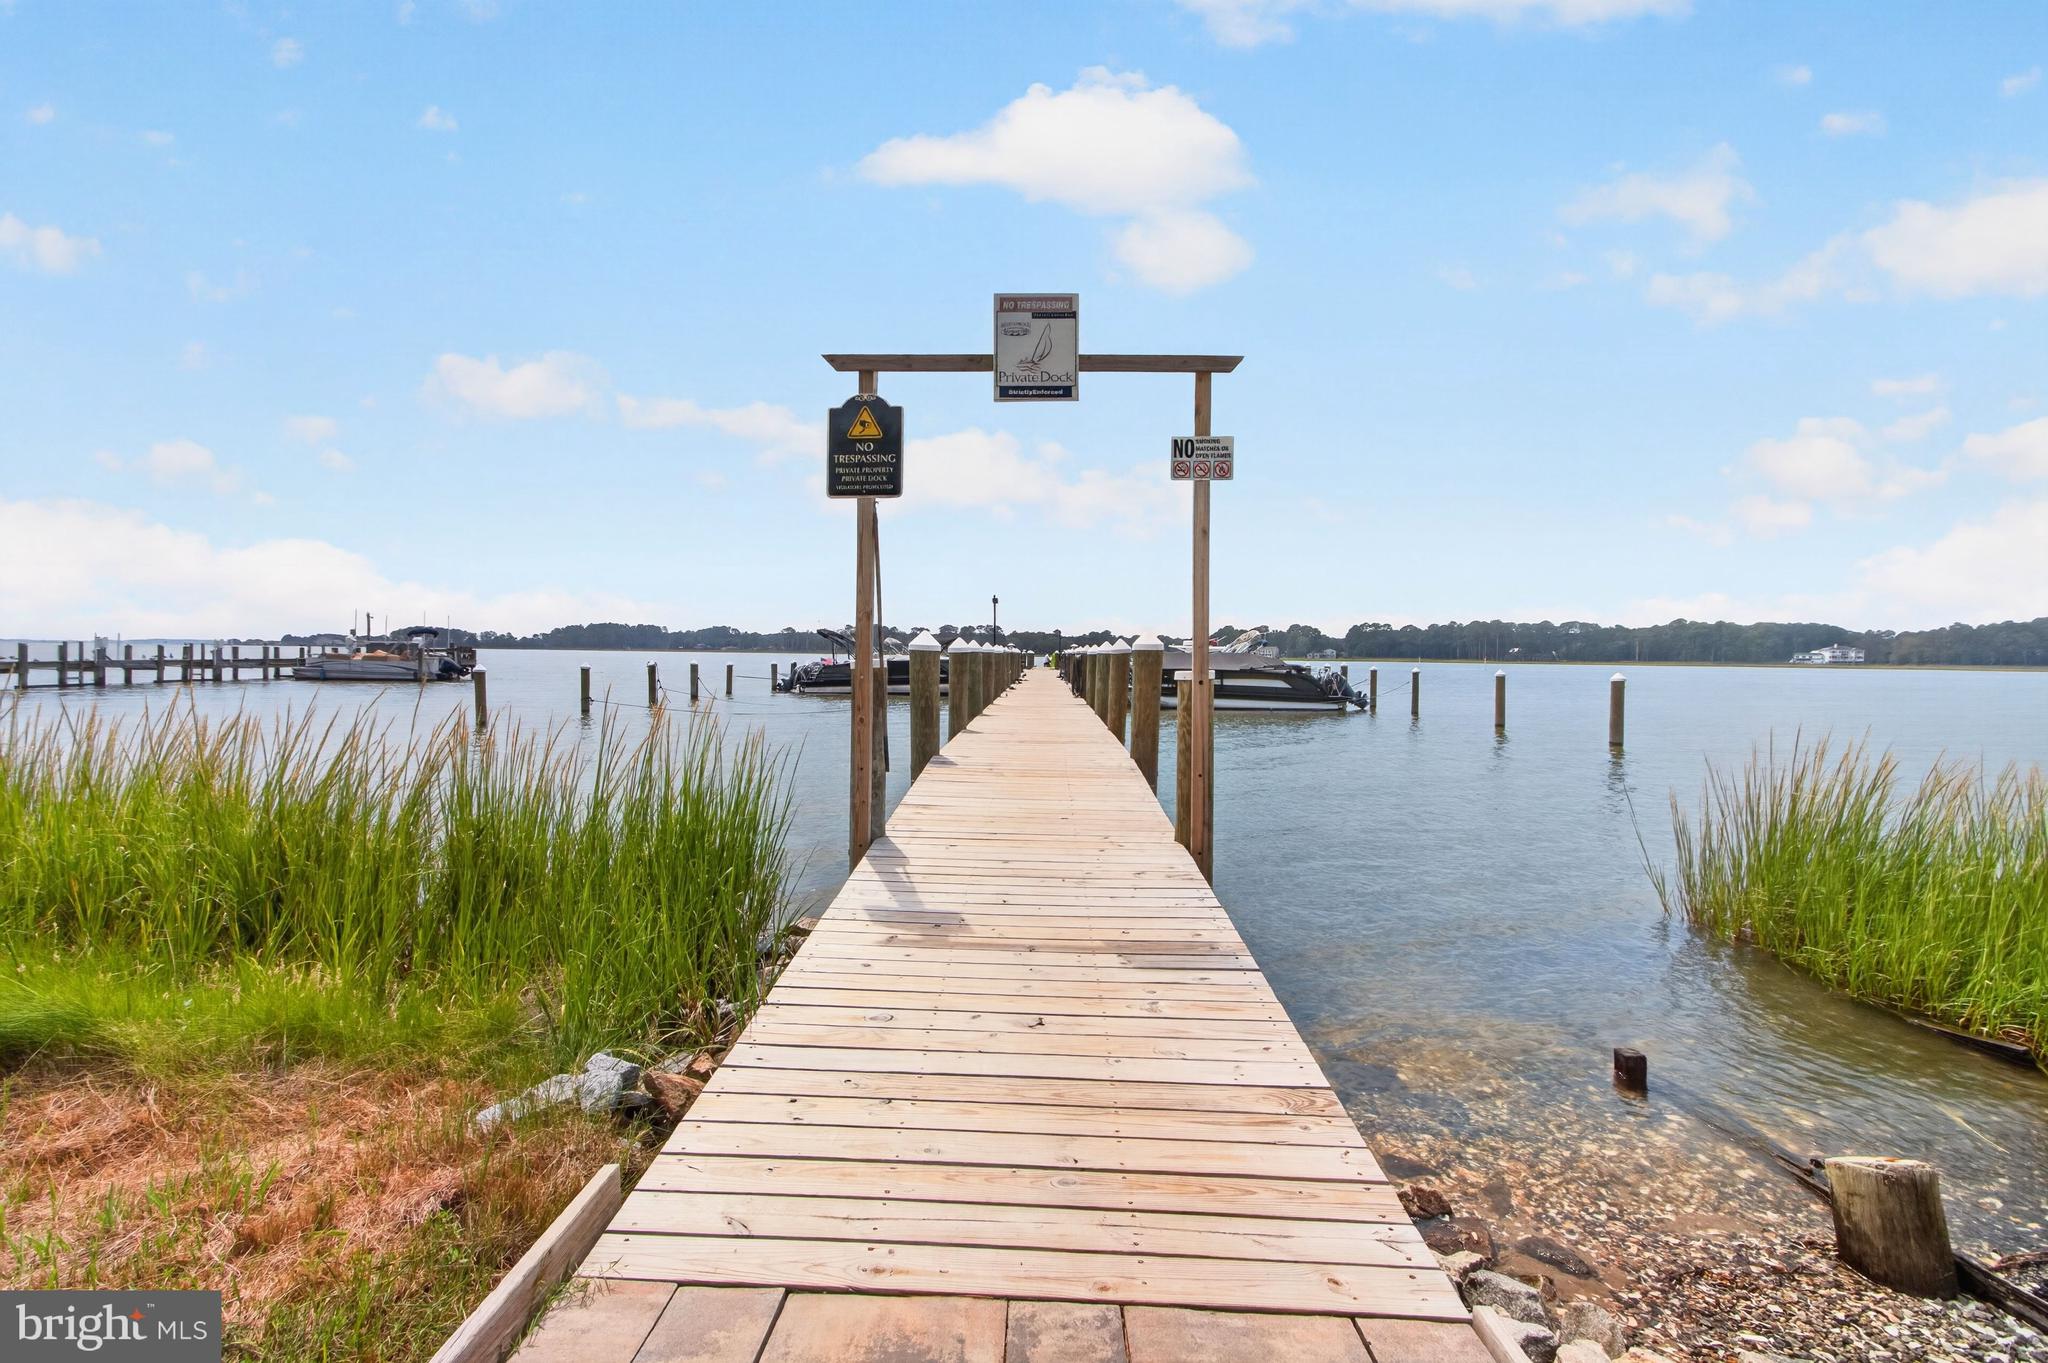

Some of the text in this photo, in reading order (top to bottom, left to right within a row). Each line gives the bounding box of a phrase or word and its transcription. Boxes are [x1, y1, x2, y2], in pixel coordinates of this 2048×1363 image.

[1003, 301, 1070, 309] NO TRESPASSING
[999, 371, 1073, 383] Private Dock
[856, 442, 874, 452] NO
[1173, 439, 1195, 458] NO
[833, 454, 896, 463] TRESPASSING
